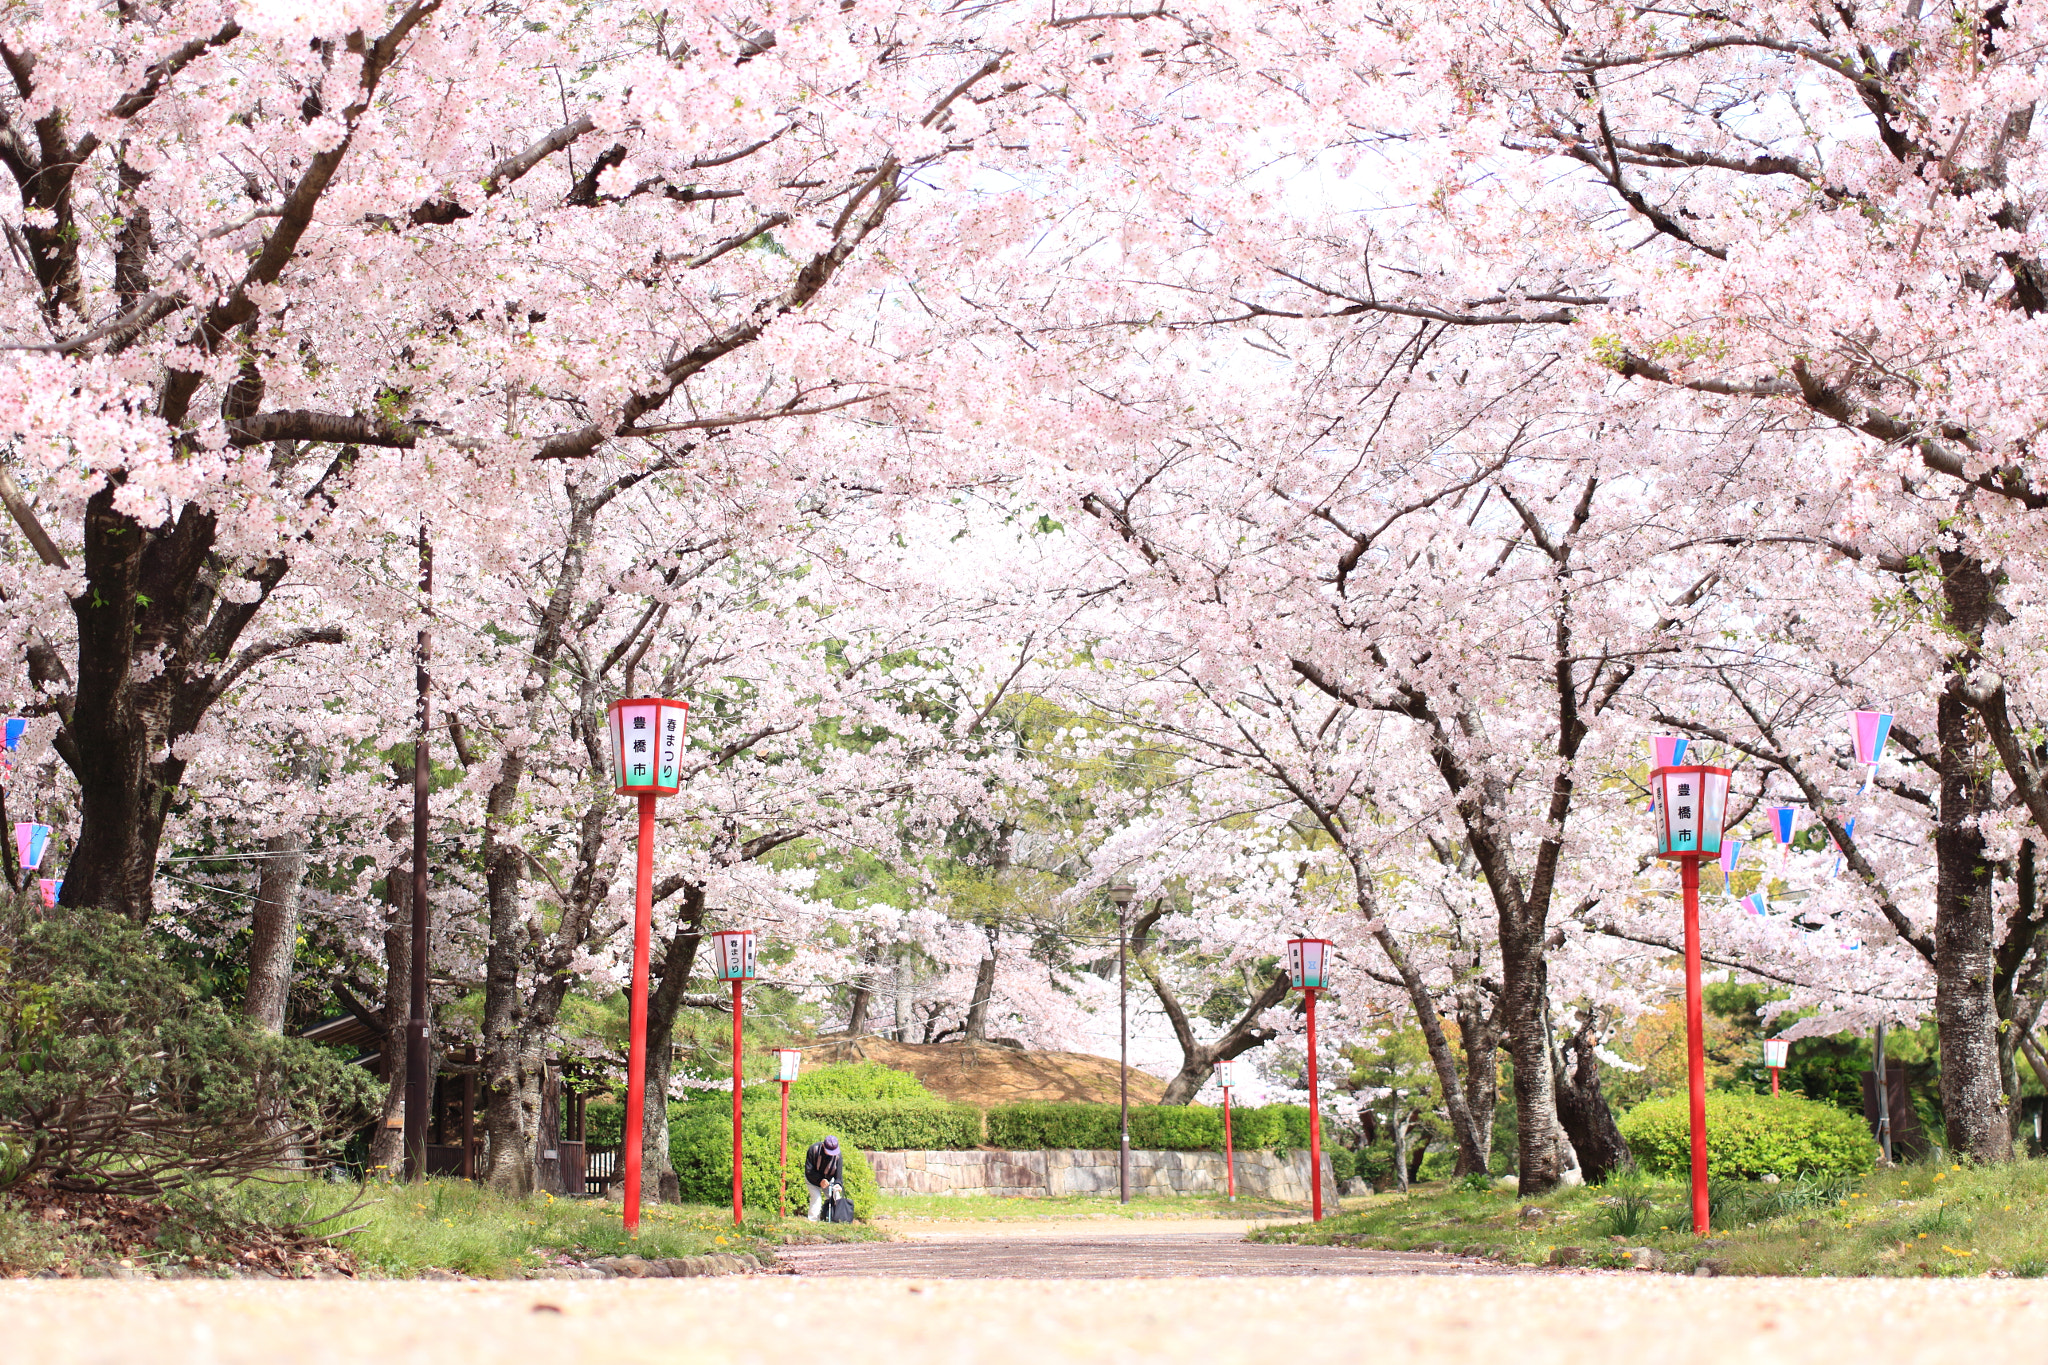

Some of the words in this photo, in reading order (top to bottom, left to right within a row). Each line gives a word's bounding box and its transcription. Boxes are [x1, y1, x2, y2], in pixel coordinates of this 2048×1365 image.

[633, 716, 646, 776] 豊橋市
[664, 719, 676, 778] 春まつり
[1678, 783, 1691, 842] 豊橋市
